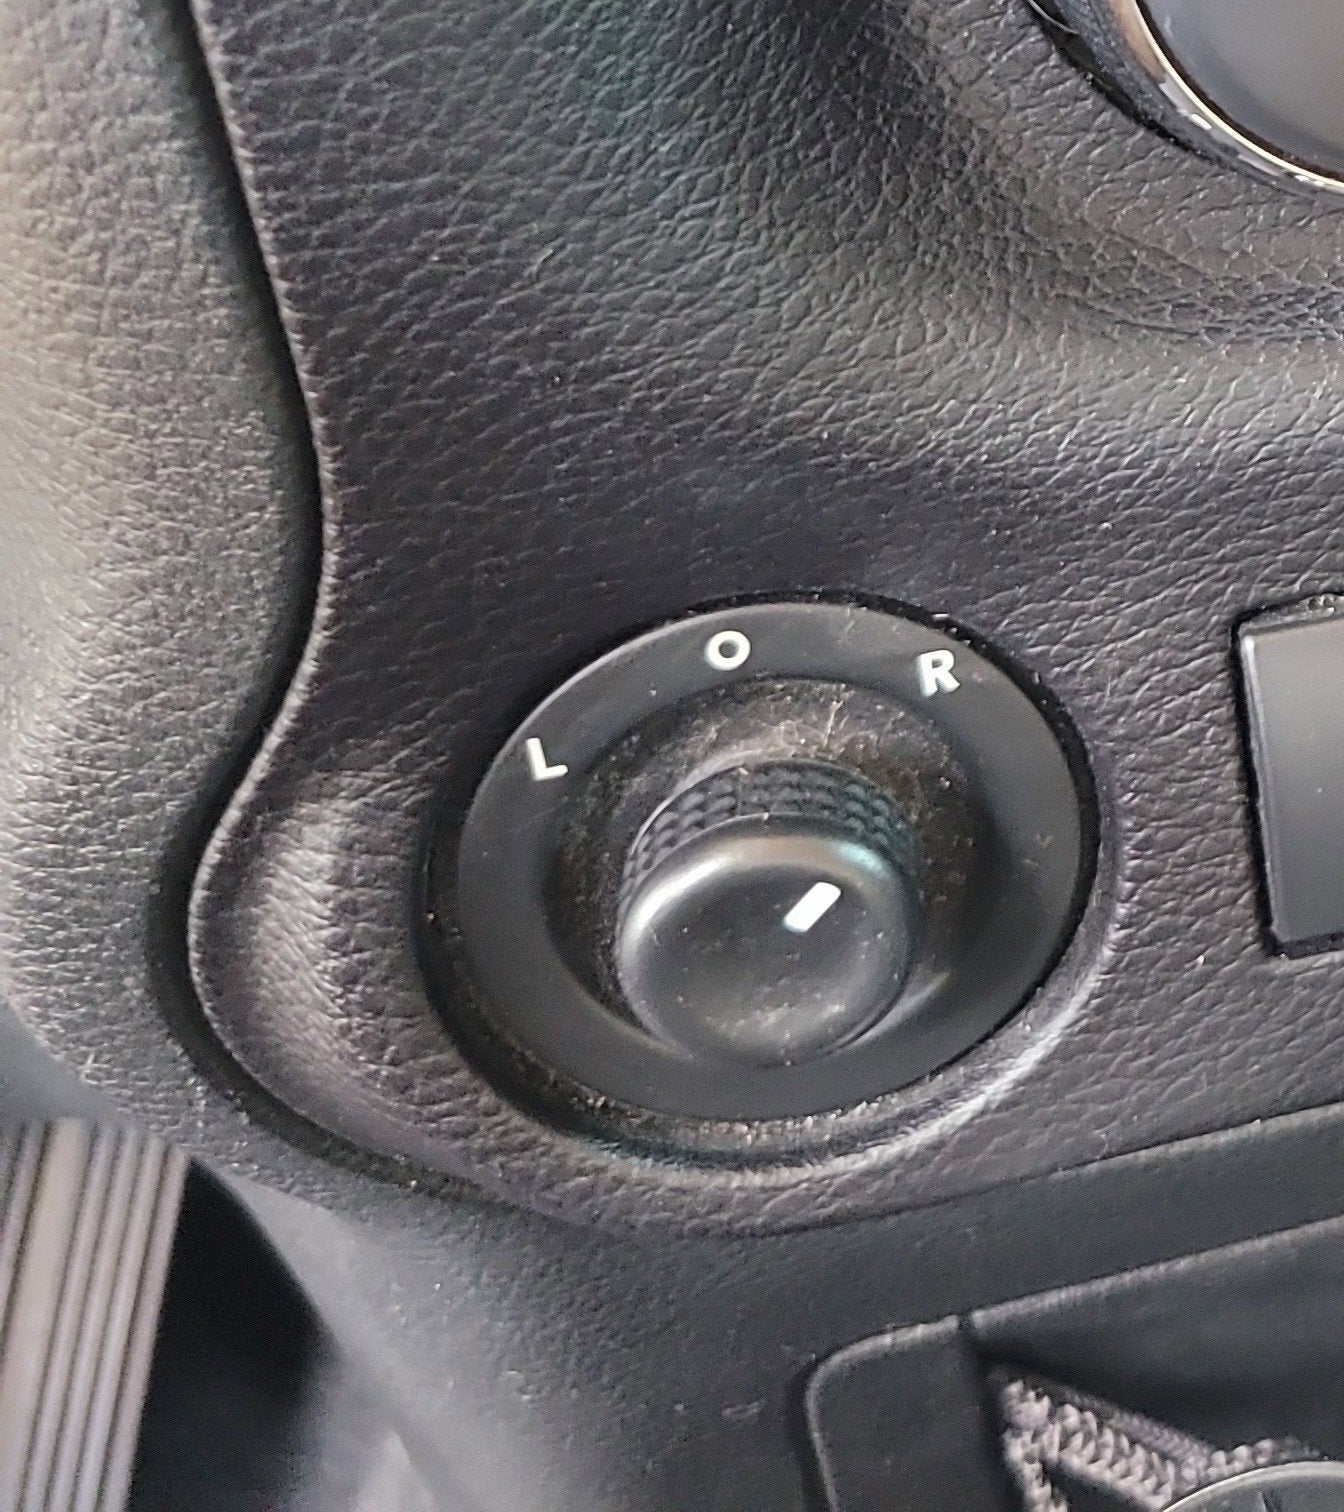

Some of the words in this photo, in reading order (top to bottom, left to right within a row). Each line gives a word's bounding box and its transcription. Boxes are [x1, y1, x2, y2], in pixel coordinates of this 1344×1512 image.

[706, 630, 751, 671] O
[918, 648, 961, 697] R
[525, 737, 568, 782] L
